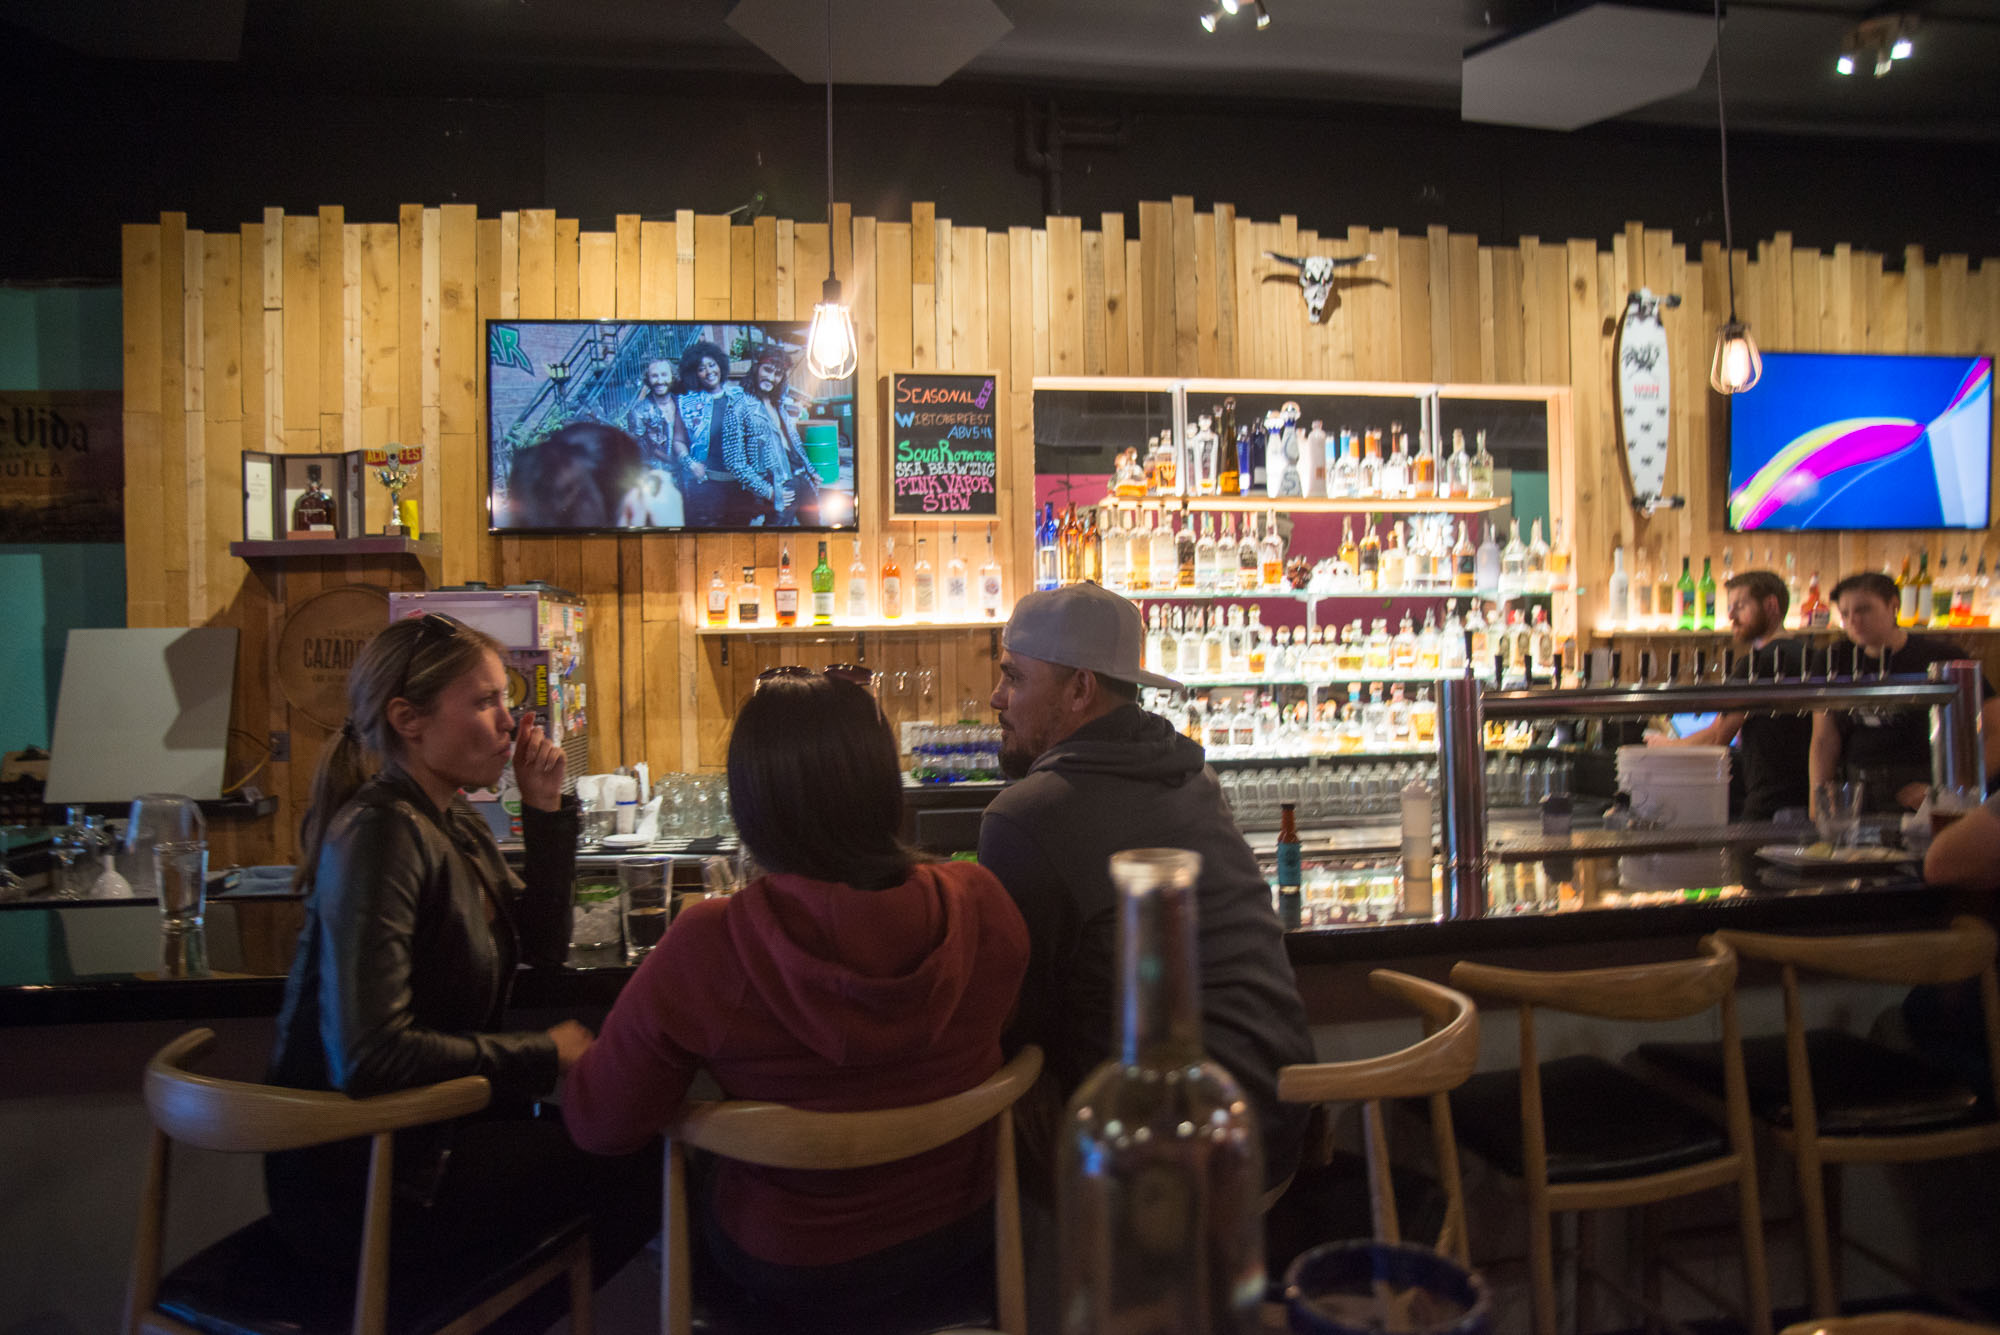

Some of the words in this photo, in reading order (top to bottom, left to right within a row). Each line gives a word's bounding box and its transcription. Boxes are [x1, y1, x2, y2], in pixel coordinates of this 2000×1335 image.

[896, 378, 976, 404] SEASONAL
[0, 461, 64, 477] UILA
[895, 461, 924, 478] SKA
[928, 461, 995, 478] BREWING
[895, 475, 942, 496] PINK
[942, 475, 994, 493] VAPOR
[922, 491, 971, 512] STEW
